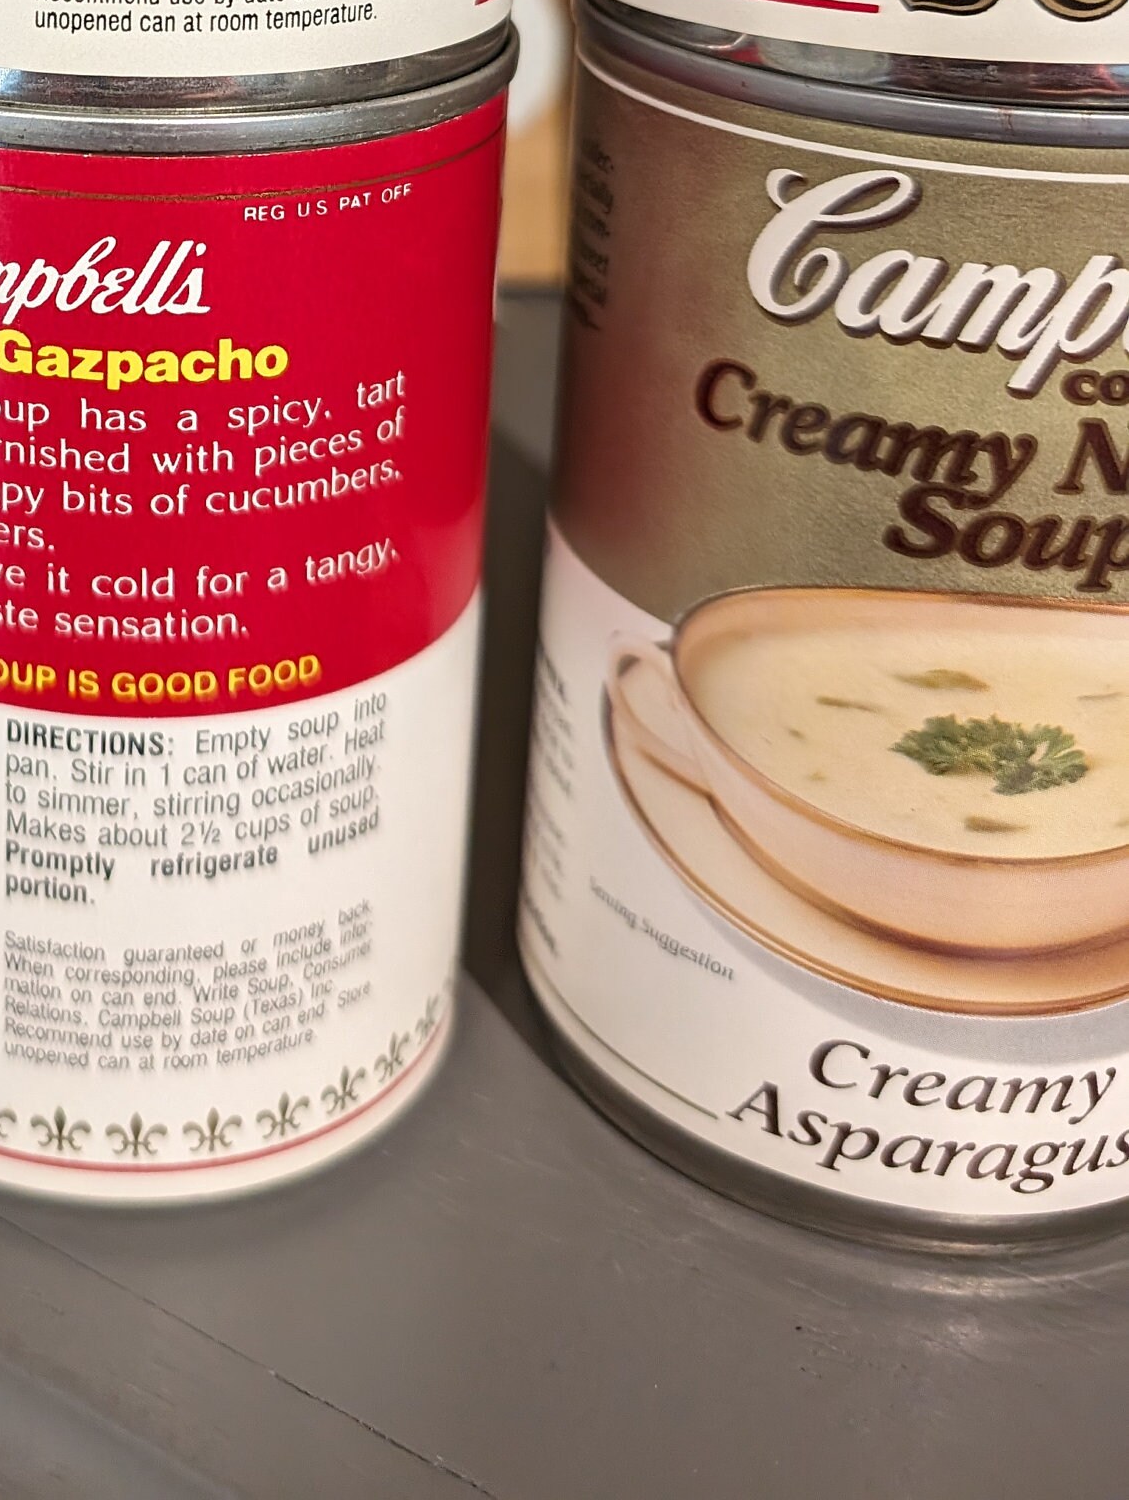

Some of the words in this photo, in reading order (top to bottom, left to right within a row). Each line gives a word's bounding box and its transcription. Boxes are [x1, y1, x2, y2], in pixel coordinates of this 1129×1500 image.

[244, 204, 286, 222] REG
[339, 192, 371, 211] PAT
[381, 182, 412, 203] OFF
[80, 398, 147, 432] has
[177, 409, 197, 432] a
[358, 370, 405, 410] tart
[695, 358, 1038, 510] Creamy
[884, 482, 1129, 593] Soup
[54, 609, 249, 644] sensation.
[69, 669, 100, 695] IS
[112, 671, 218, 702] GOOD
[228, 654, 321, 695] FOOD
[6, 717, 173, 756] DIRECTIONS:
[195, 724, 270, 756] Empty
[288, 710, 339, 741] soup
[353, 692, 388, 725] into
[641, 915, 735, 982] Suggestion
[808, 1039, 1116, 1125] Creamy
[726, 1081, 1129, 1194] Asparagus
